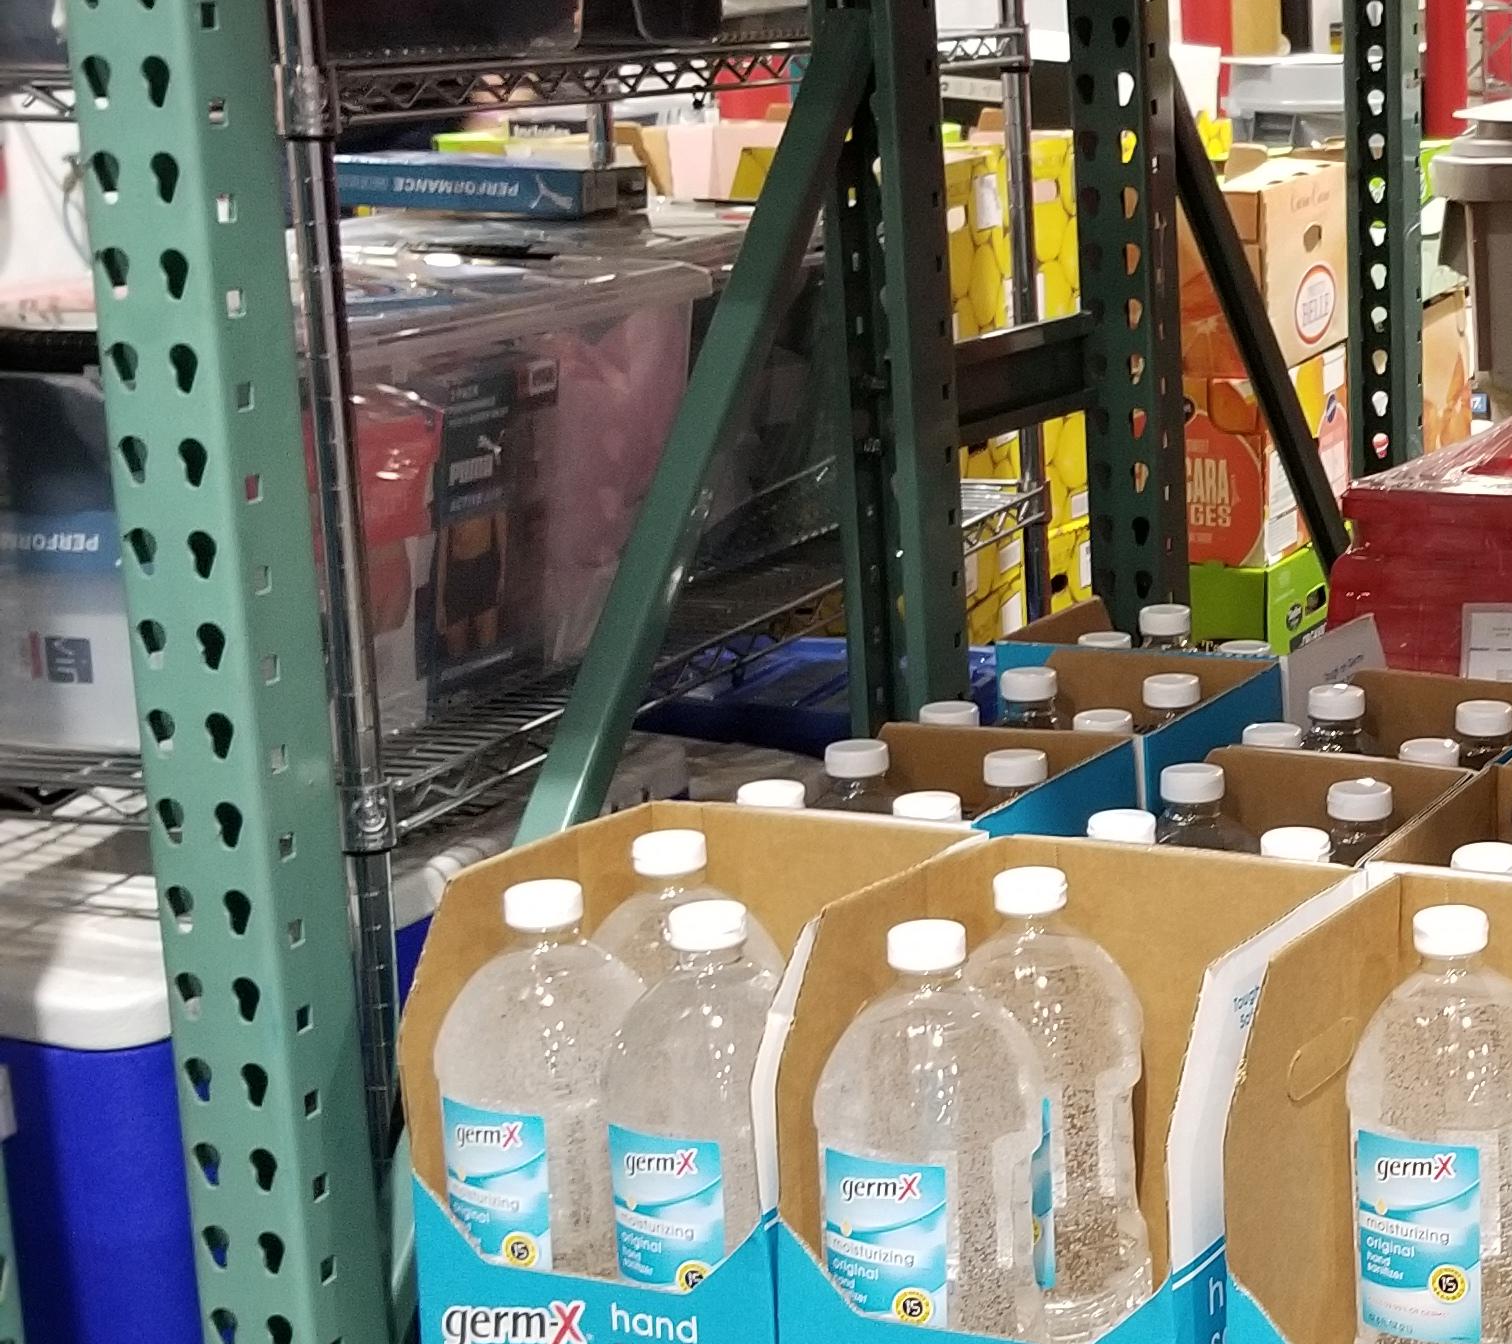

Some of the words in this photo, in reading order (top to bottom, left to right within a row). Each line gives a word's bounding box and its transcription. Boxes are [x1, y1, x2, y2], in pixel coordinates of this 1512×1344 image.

[392, 176, 521, 198] PERFORMANCE
[457, 1123, 520, 1150] germ-X
[625, 1152, 695, 1177] germ-X
[1377, 1154, 1454, 1181] germ-X
[841, 1174, 919, 1202] germ-X
[620, 1212, 696, 1241] moisturizing
[1365, 1216, 1451, 1247] moisturizing
[511, 1243, 529, 1260] 15
[621, 1232, 662, 1254] original
[831, 1236, 915, 1268] moisturizing
[1366, 1235, 1416, 1259] original
[833, 1257, 879, 1281] original
[1440, 1275, 1458, 1293] 15
[902, 1300, 922, 1318] 15
[611, 1302, 698, 1344] hand
